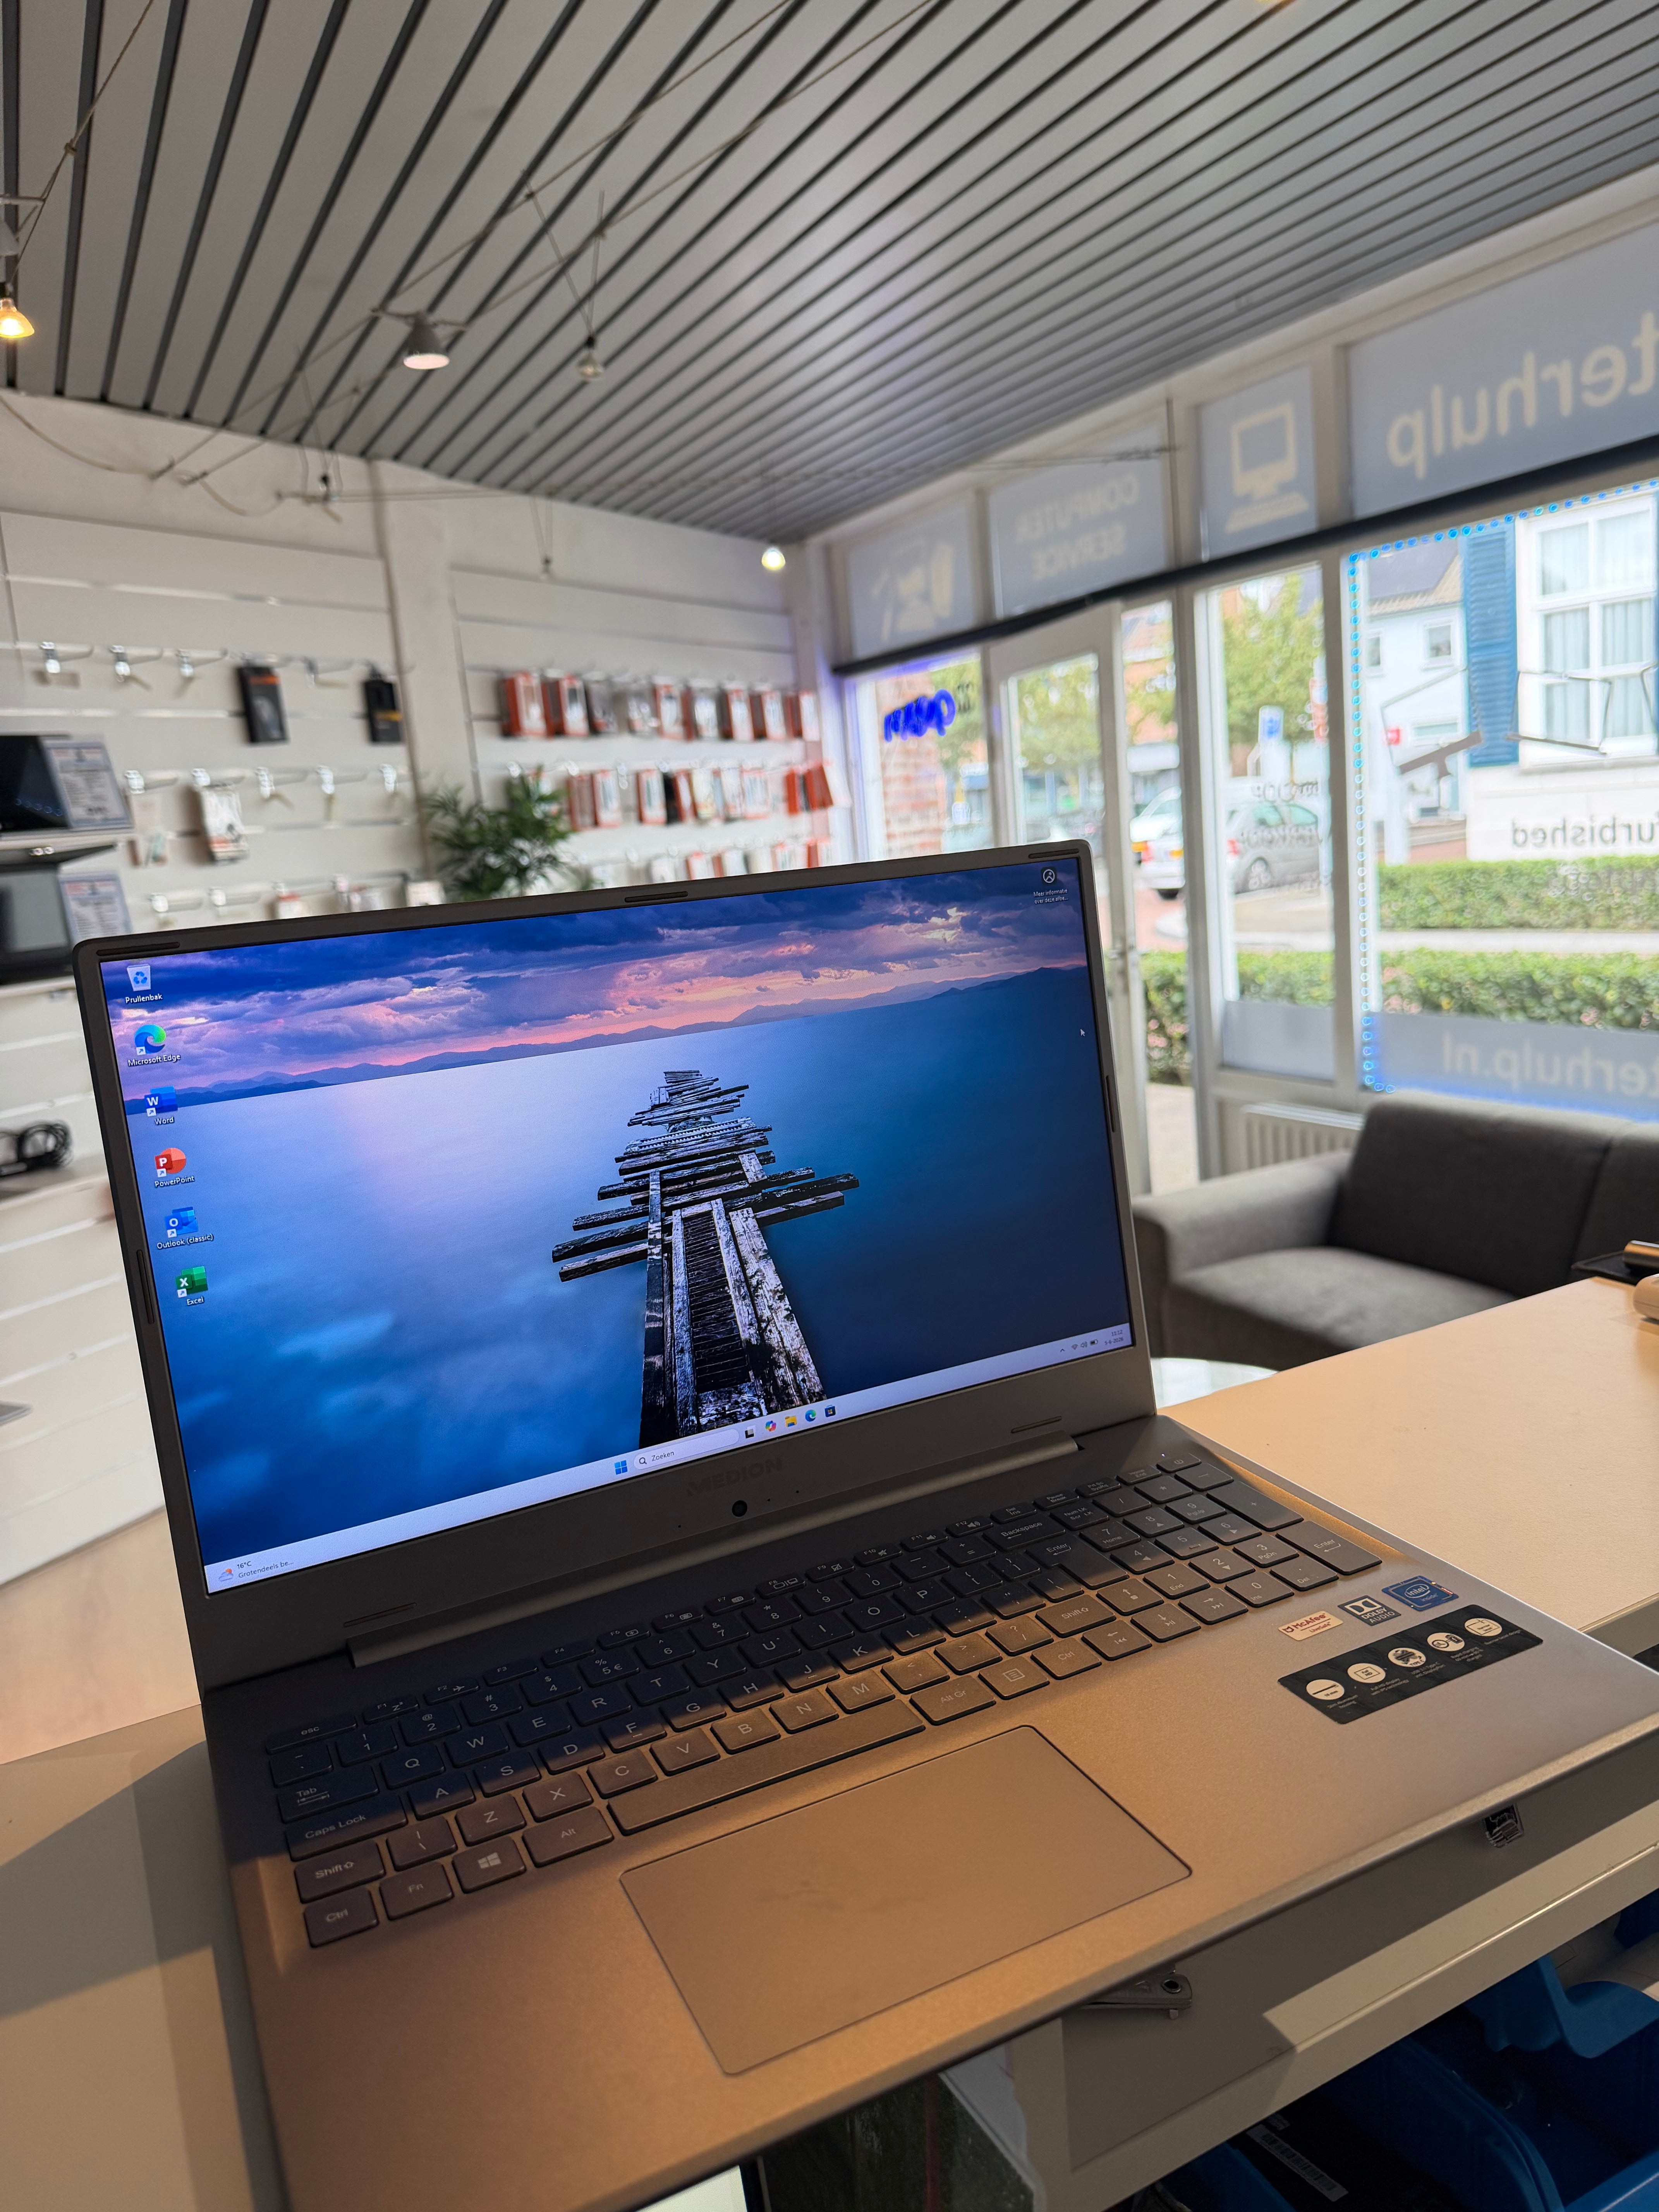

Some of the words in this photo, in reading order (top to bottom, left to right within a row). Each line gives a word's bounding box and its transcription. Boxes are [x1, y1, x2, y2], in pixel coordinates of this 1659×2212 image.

[125, 993, 163, 1004] Prullenbak
[128, 1056, 161, 1066] Microsoft
[163, 1054, 181, 1063] Edge
[147, 1096, 159, 1106] W
[155, 1116, 174, 1125] Word
[159, 1157, 167, 1166] P
[155, 1175, 194, 1187] PowerPoint
[157, 1238, 185, 1249] Outlook
[186, 1233, 214, 1245] (classic)
[180, 1278, 189, 1287] X
[187, 1297, 204, 1306] Excel
[651, 1449, 674, 1462] Zoeken
[687, 1456, 783, 1498] MEDION
[1001, 1522, 1043, 1537] Backspace
[1102, 1535, 1122, 1544] Home
[1314, 1538, 1336, 1549] Enter
[1046, 1543, 1068, 1553] Enter
[1258, 1551, 1277, 1560] PgDn
[237, 1561, 252, 1569] 16°C
[238, 1563, 279, 1578] Grotendeels
[1297, 1576, 1310, 1584] Del
[1169, 1583, 1185, 1591] End
[916, 1589, 928, 1599] P
[867, 1606, 881, 1616] O
[1061, 1609, 1082, 1620] Shift
[1361, 1607, 1387, 1620] DOLBY
[1369, 1611, 1395, 1623] AUDIO
[819, 1624, 826, 1633] I
[906, 1630, 920, 1638] L
[762, 1640, 776, 1650] U
[852, 1646, 869, 1656] K
[1057, 1650, 1075, 1661] Ctrl
[707, 1659, 718, 1668] Y
[804, 1664, 812, 1674] J
[650, 1678, 661, 1687] T
[743, 1683, 759, 1694] H
[852, 1683, 870, 1695] M
[591, 1697, 607, 1708] R
[940, 1695, 953, 1704] Alt
[489, 1704, 498, 1712] 3
[686, 1703, 701, 1712] G
[796, 1703, 812, 1715] N
[427, 1723, 437, 1731] 2
[532, 1717, 546, 1728] E
[626, 1723, 637, 1733] F
[738, 1723, 752, 1734] B
[467, 1736, 484, 1748] W
[563, 1744, 578, 1755] D
[676, 1742, 689, 1754] V
[405, 1758, 420, 1768] Q
[500, 1765, 514, 1776] S
[615, 1765, 630, 1776] C
[296, 1788, 317, 1797] Tab
[436, 1788, 449, 1799] A
[549, 1787, 567, 1801] X
[483, 1811, 498, 1824] Z
[305, 1824, 336, 1839] Caps
[338, 1815, 366, 1828] Lock
[561, 1828, 577, 1839] Alt
[314, 1863, 343, 1879] Shift
[408, 1883, 424, 1893] Fn
[326, 1908, 349, 1923] Ctrl
